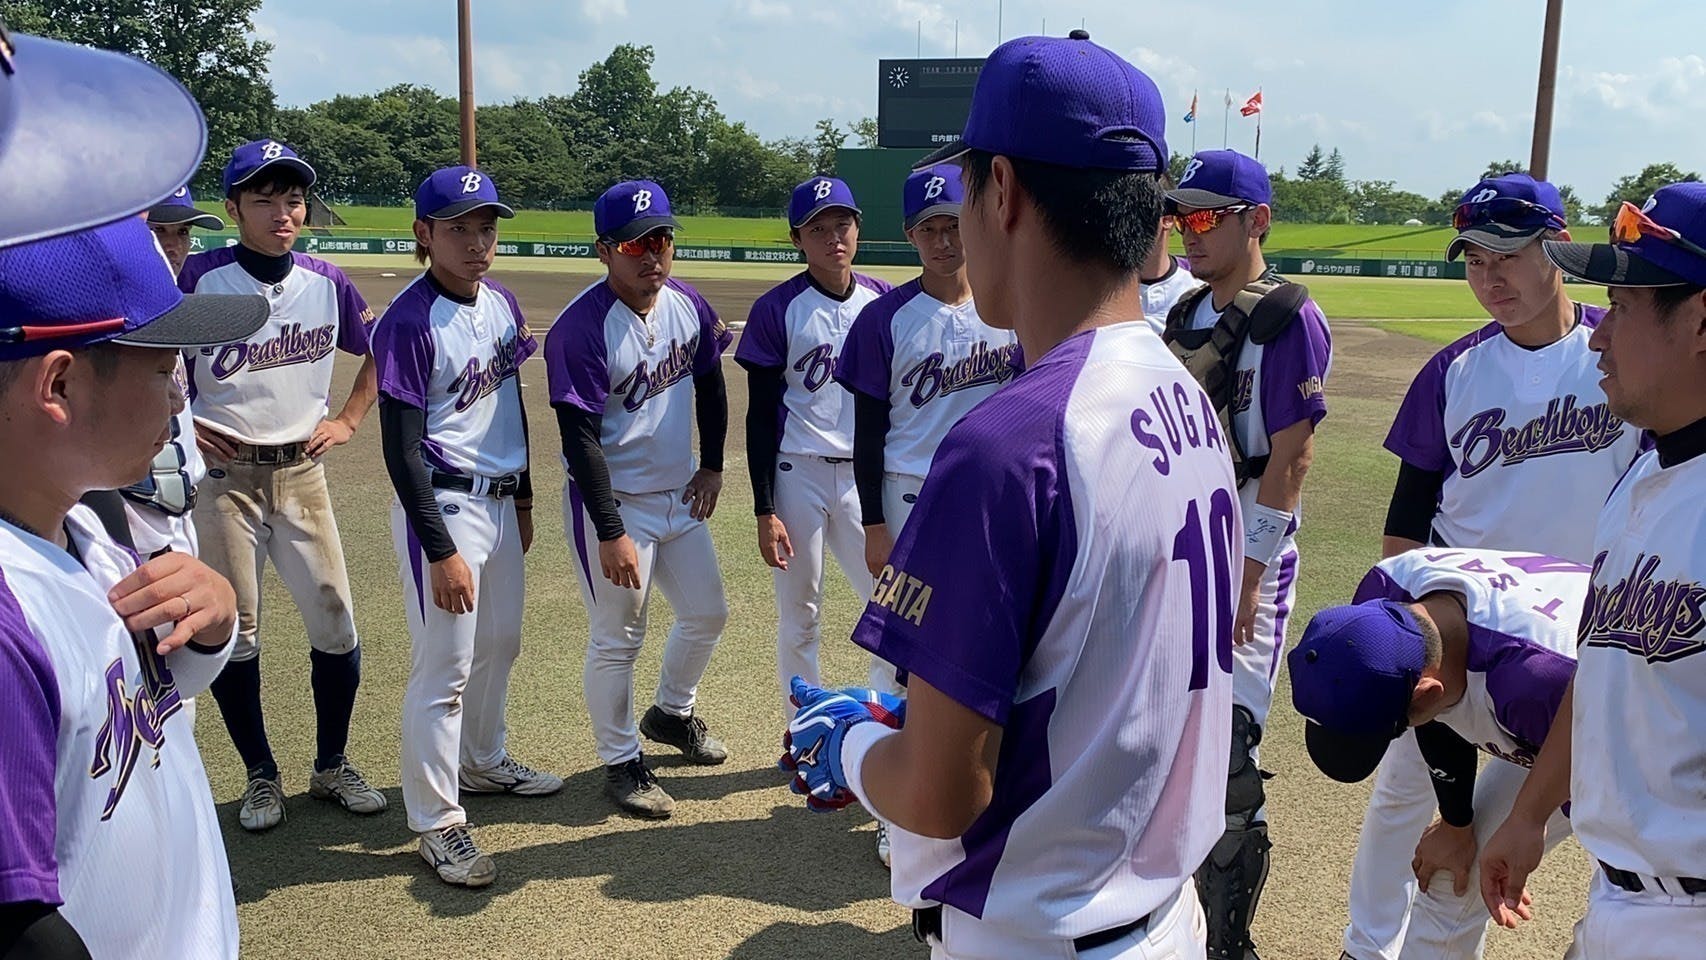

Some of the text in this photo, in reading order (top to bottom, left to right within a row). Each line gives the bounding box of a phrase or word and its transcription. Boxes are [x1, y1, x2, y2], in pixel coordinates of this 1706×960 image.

[261, 141, 283, 161] B
[460, 171, 482, 195] B
[813, 180, 832, 201] B
[924, 176, 948, 201] B
[632, 189, 653, 215] B
[319, 241, 369, 251] 山形信用金庫
[546, 244, 590, 256] ヤマサワ
[1316, 264, 1361, 275] きらやか銀行
[1387, 264, 1439, 277] 愛和建設
[1130, 381, 1226, 476] SUGA
[1172, 487, 1233, 692] 10
